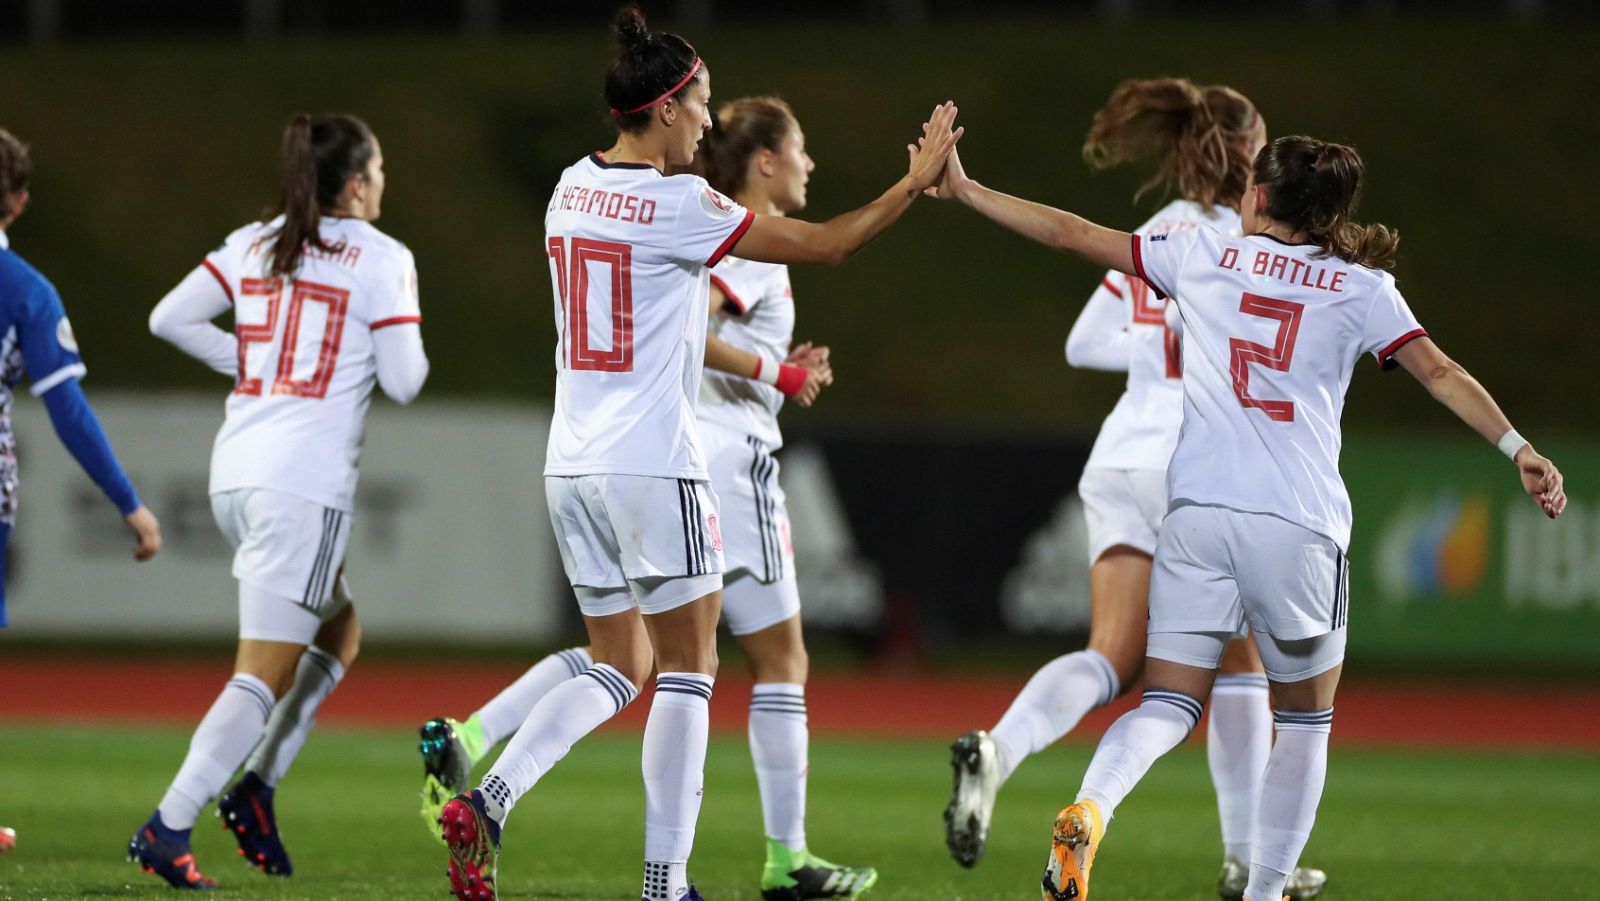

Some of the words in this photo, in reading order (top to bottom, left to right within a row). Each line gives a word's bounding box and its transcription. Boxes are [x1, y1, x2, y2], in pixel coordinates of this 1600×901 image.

[560, 185, 657, 226] HERMOSO
[547, 236, 634, 372] 10
[1219, 247, 1242, 272] D.
[1252, 251, 1347, 292] BATLLE
[235, 277, 351, 399] 20
[1229, 292, 1305, 422] 2
